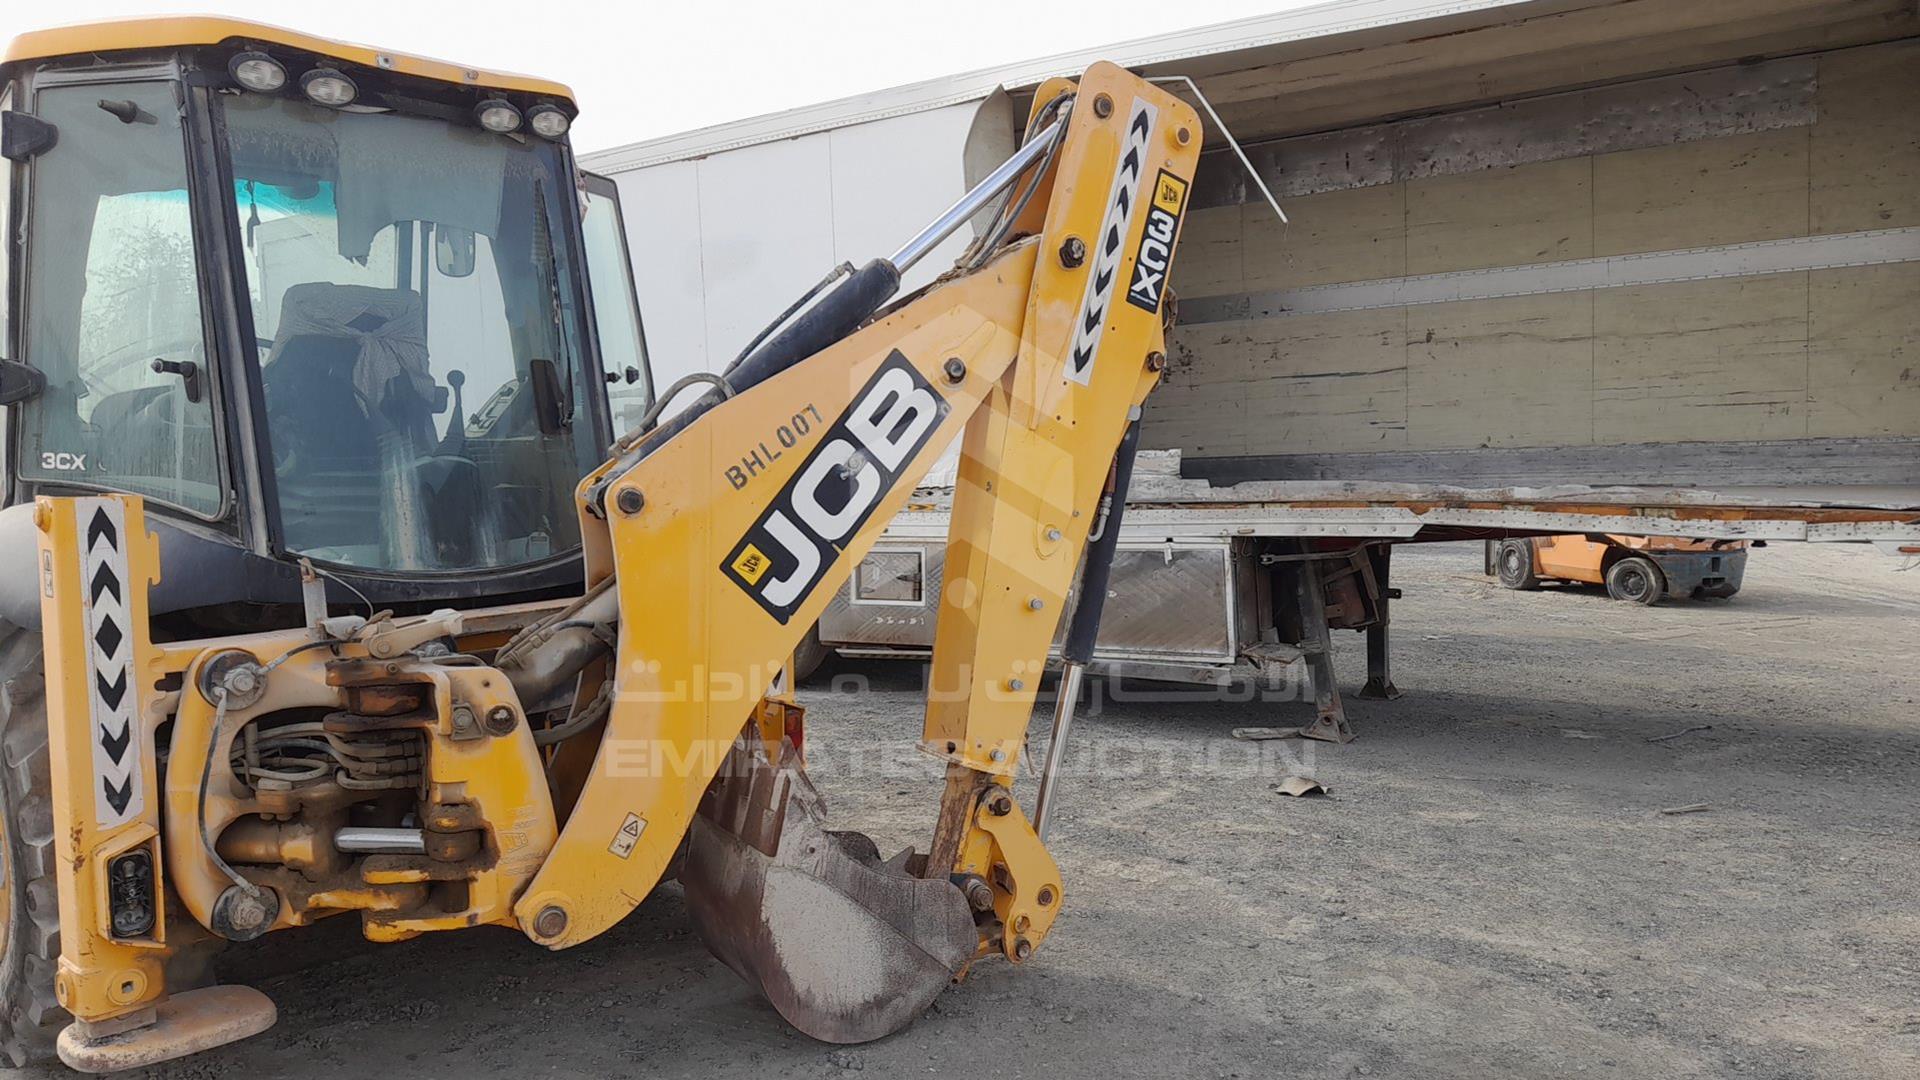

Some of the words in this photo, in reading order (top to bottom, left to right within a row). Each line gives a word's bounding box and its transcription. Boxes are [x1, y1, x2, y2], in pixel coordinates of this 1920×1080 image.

[1131, 210, 1175, 301] 3CX
[41, 452, 87, 471] 3CX
[724, 403, 823, 490] BHL007
[760, 367, 937, 607] JCB
